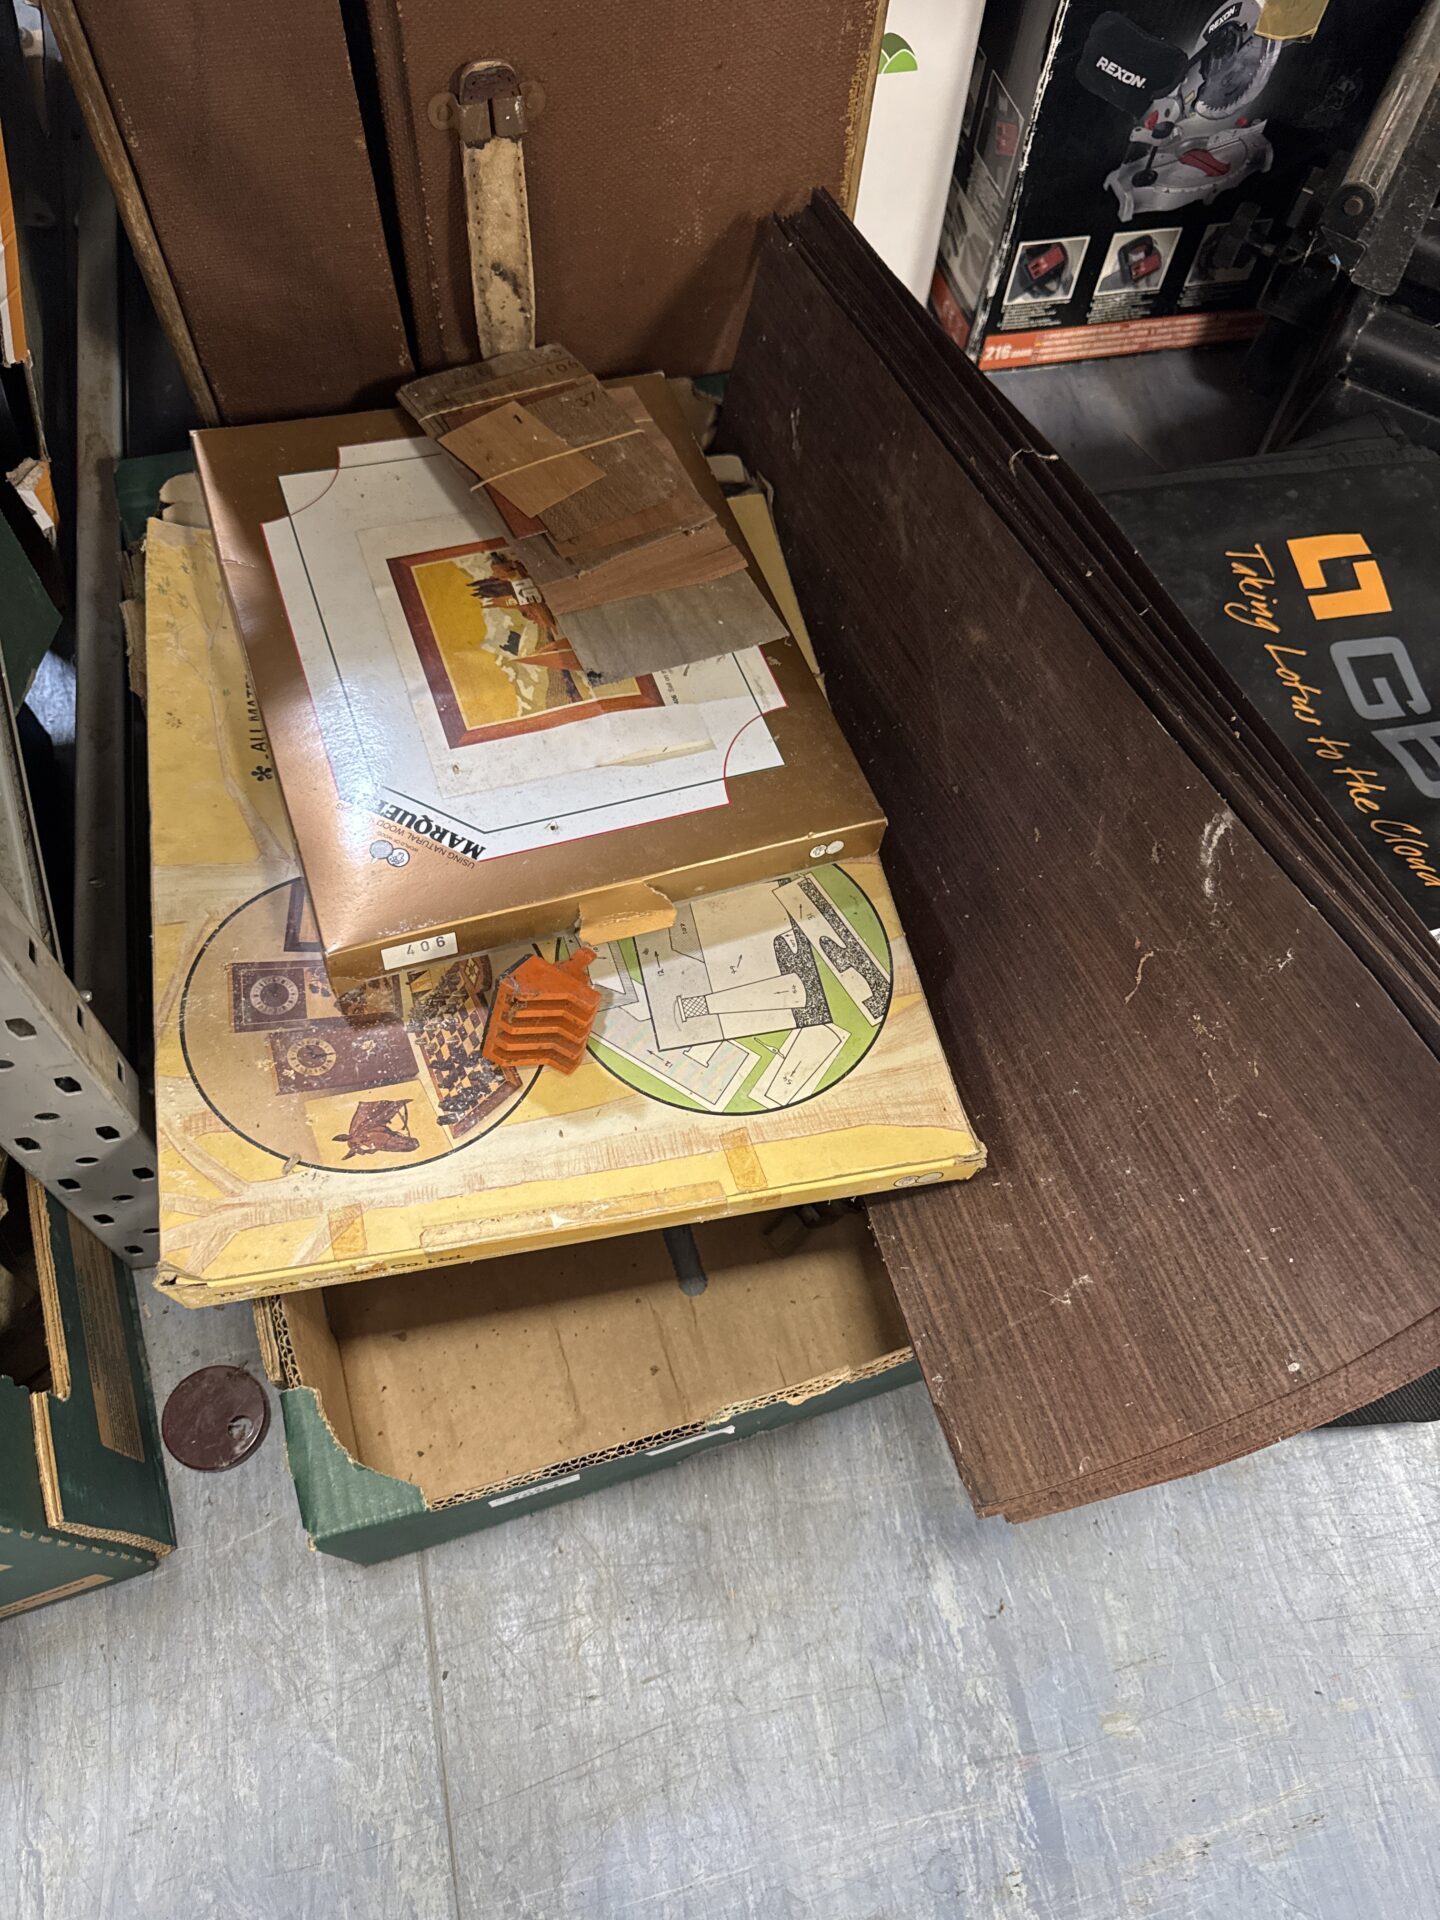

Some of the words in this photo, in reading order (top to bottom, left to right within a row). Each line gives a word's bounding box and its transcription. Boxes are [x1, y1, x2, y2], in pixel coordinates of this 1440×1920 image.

[1208, 6, 1237, 34] REXON
[1096, 56, 1148, 89] REXON
[1224, 542, 1281, 634] Taking
[1307, 735, 1351, 761] to
[1332, 766, 1387, 813] the
[376, 819, 406, 836] WOOD
[407, 834, 446, 856] NATURAL
[447, 851, 476, 869] USING
